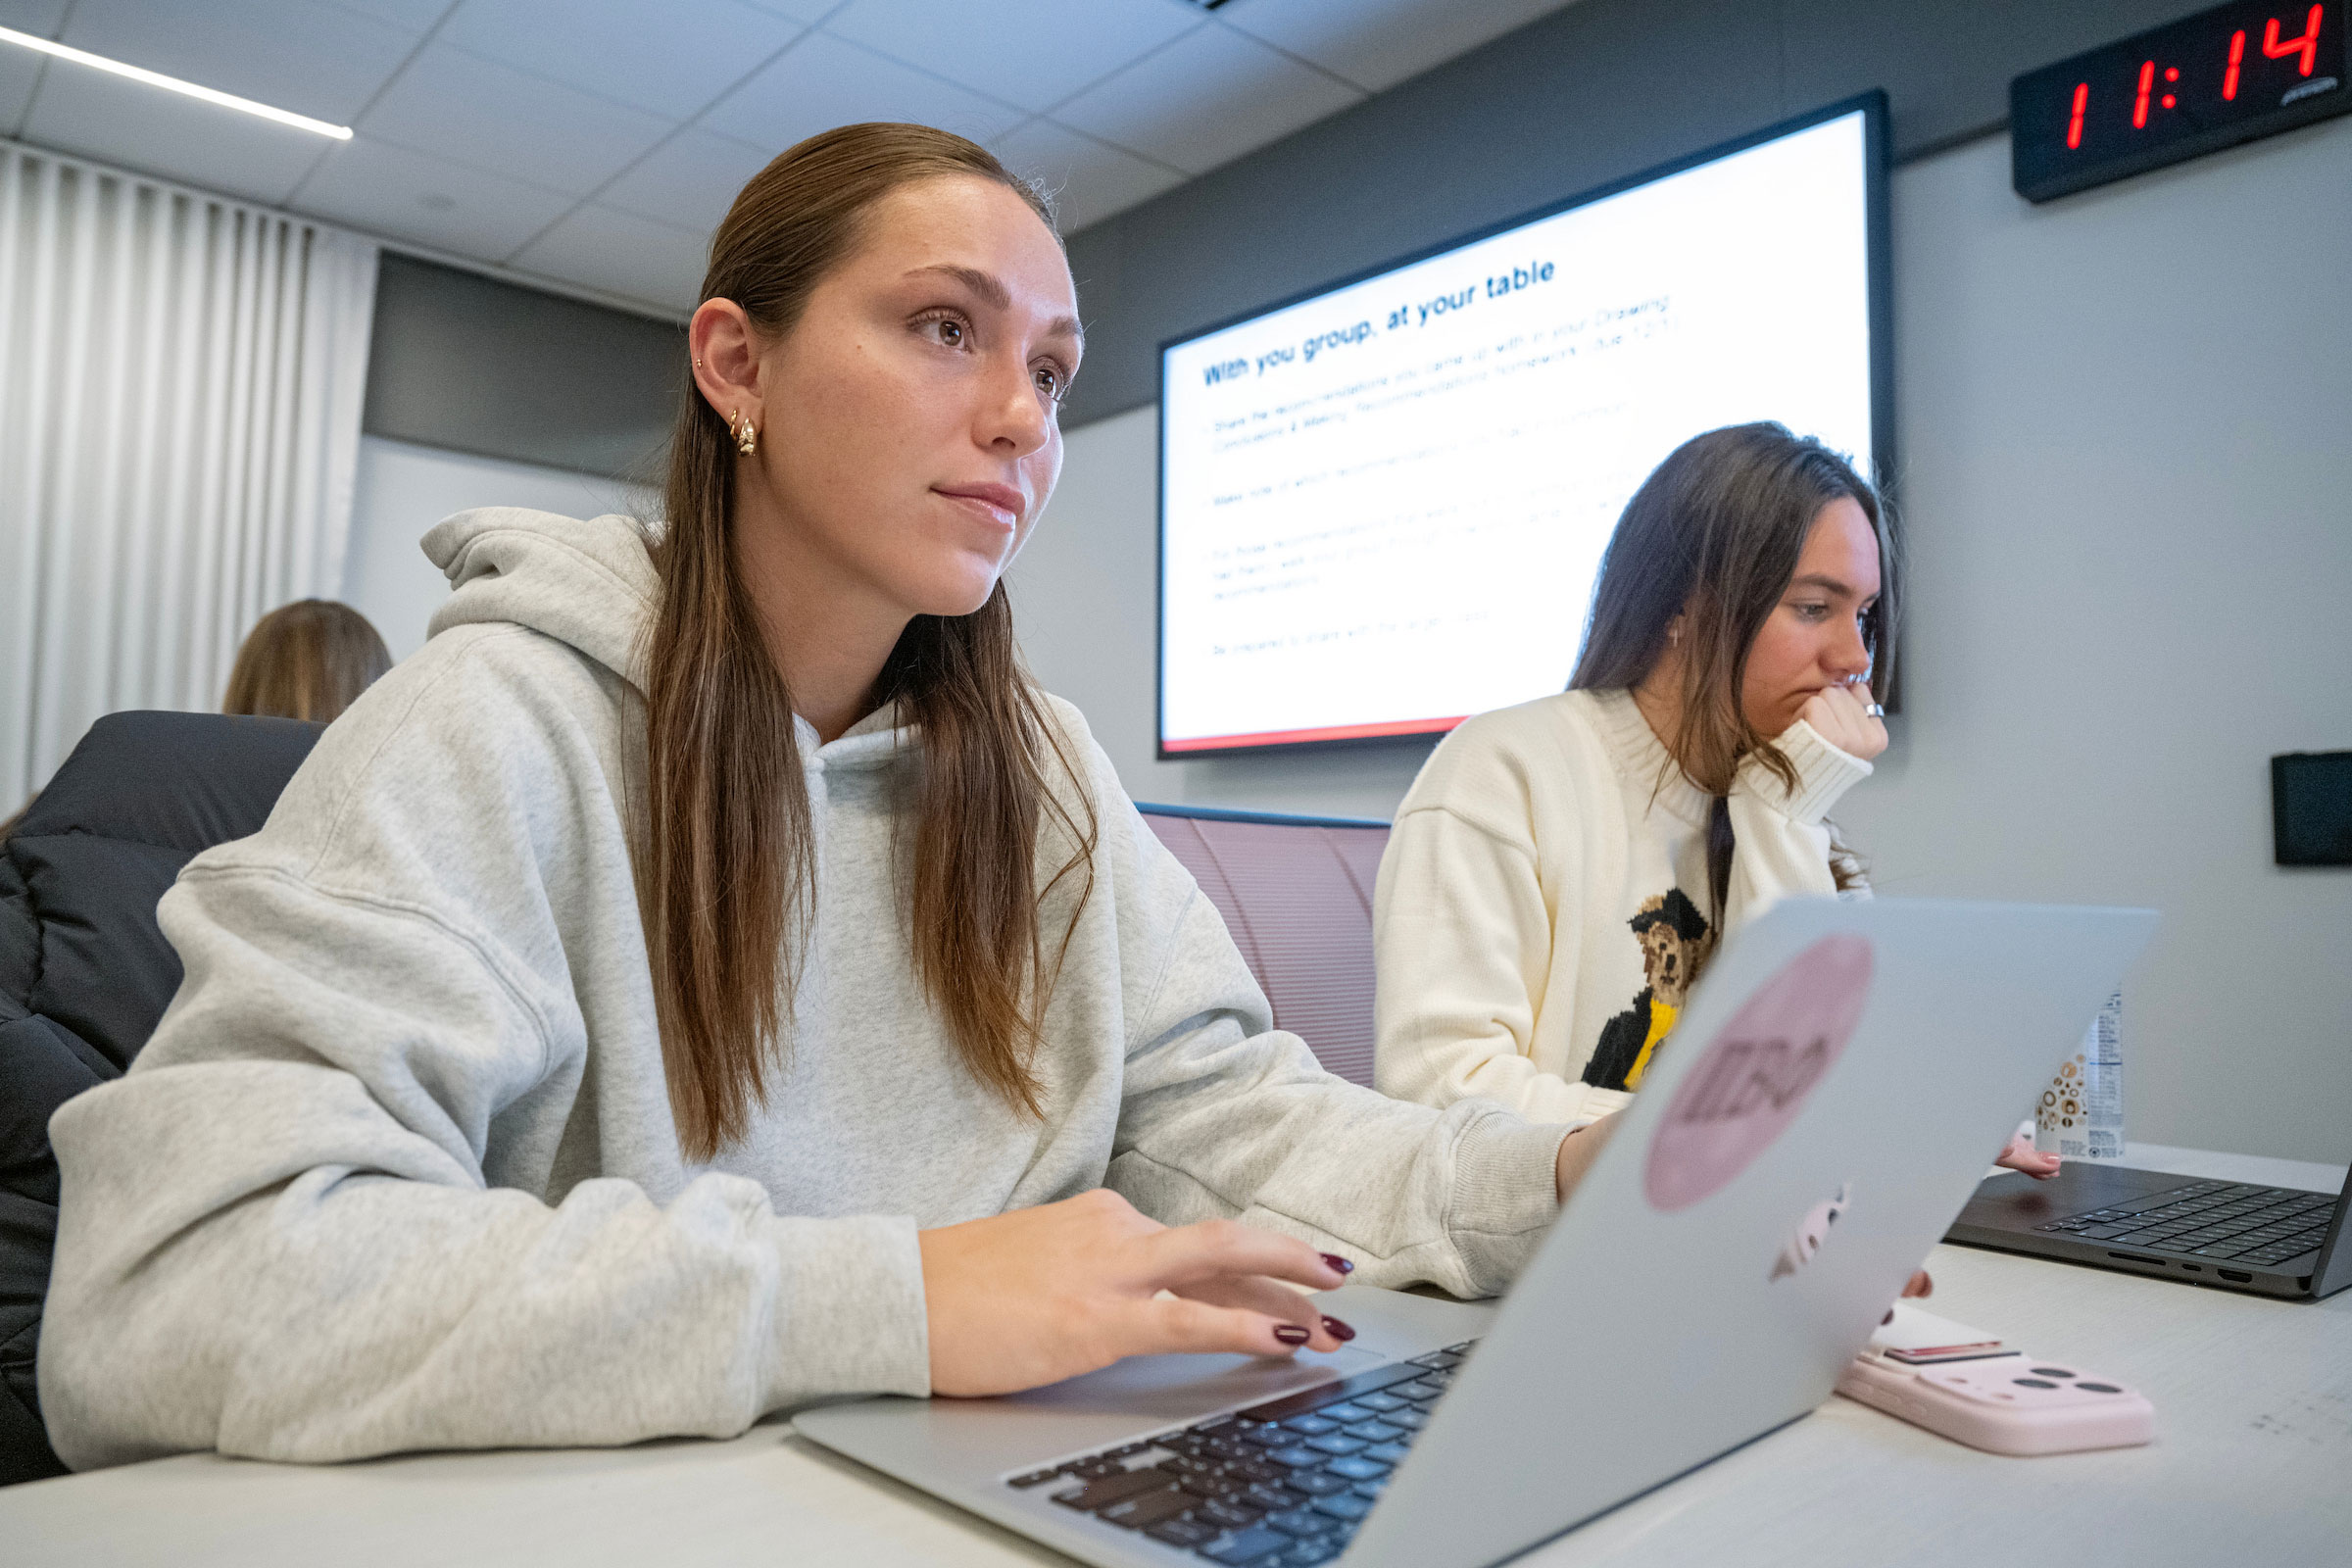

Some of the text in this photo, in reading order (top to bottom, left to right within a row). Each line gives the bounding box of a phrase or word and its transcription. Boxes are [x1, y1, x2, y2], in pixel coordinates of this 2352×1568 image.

[2066, 2, 2324, 150] 11:14
[1202, 260, 1555, 387] With you group, at your table
